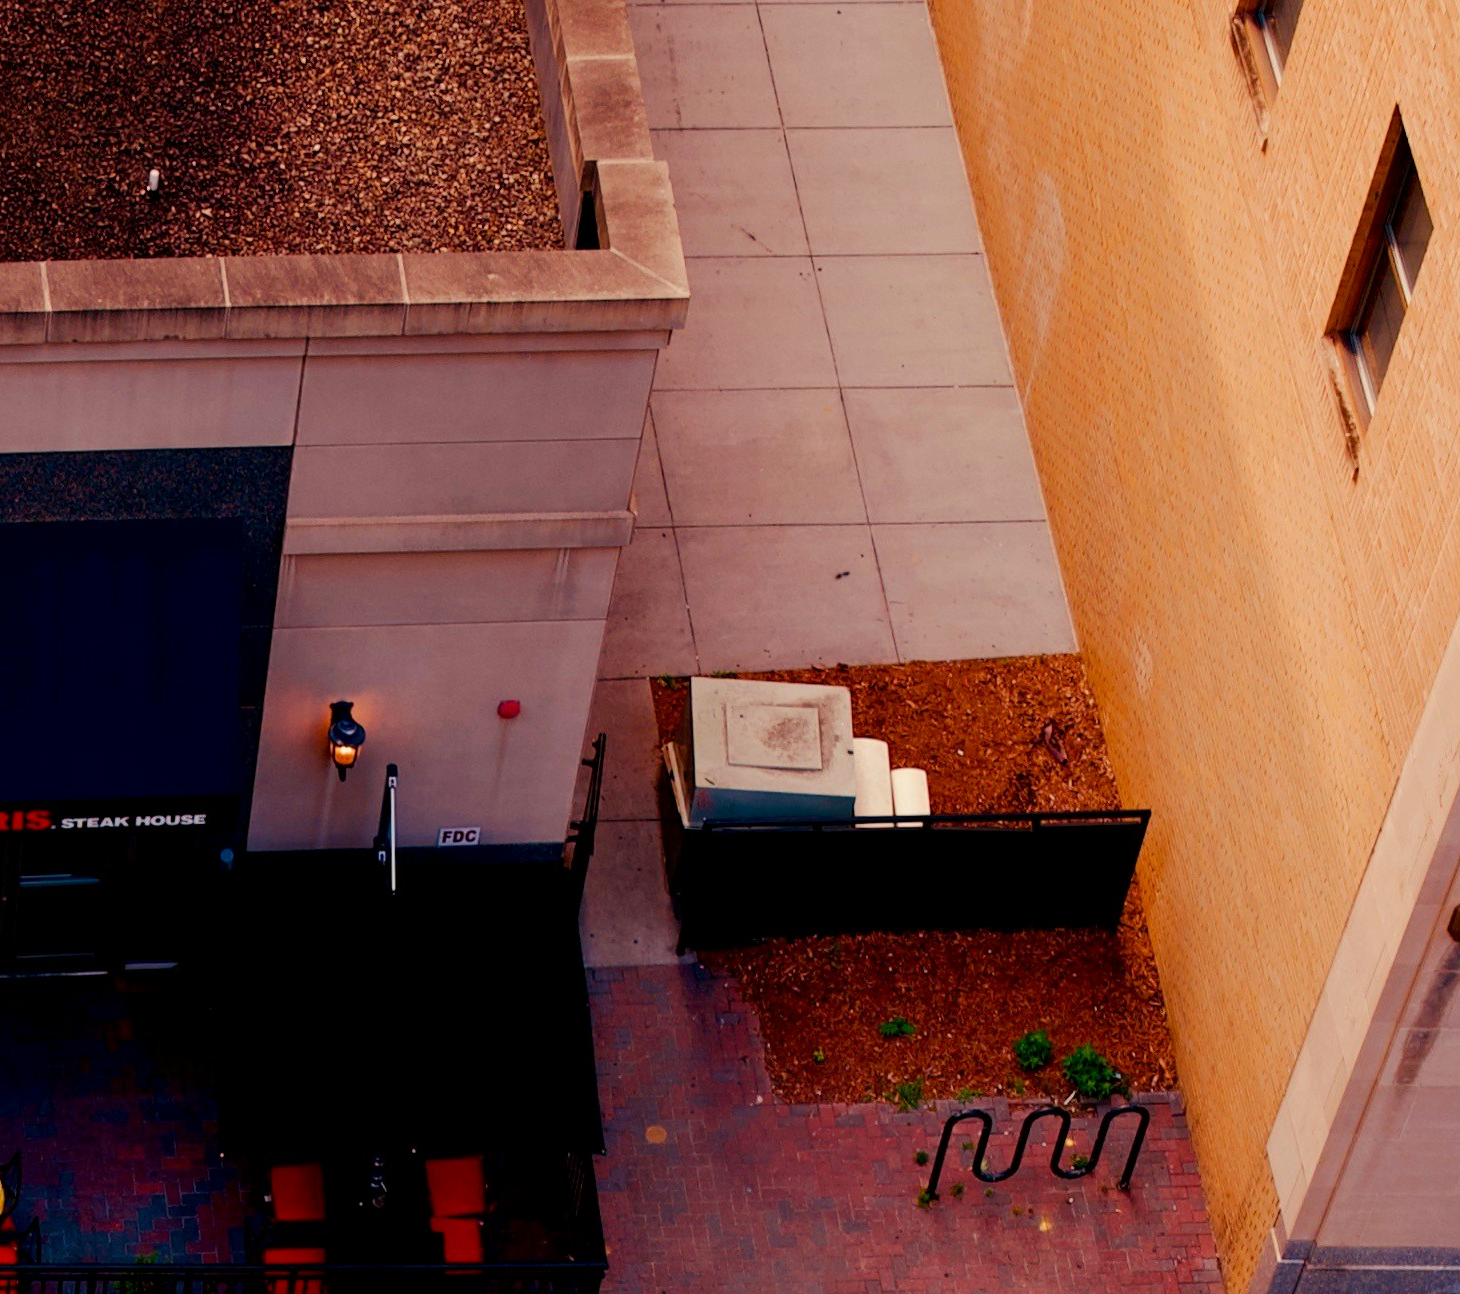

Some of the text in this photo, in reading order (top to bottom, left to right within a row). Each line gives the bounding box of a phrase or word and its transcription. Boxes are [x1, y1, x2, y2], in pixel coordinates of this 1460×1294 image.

[61, 816, 129, 829] STEAK
[135, 814, 207, 826] HOUSE
[442, 830, 476, 843] FDC
